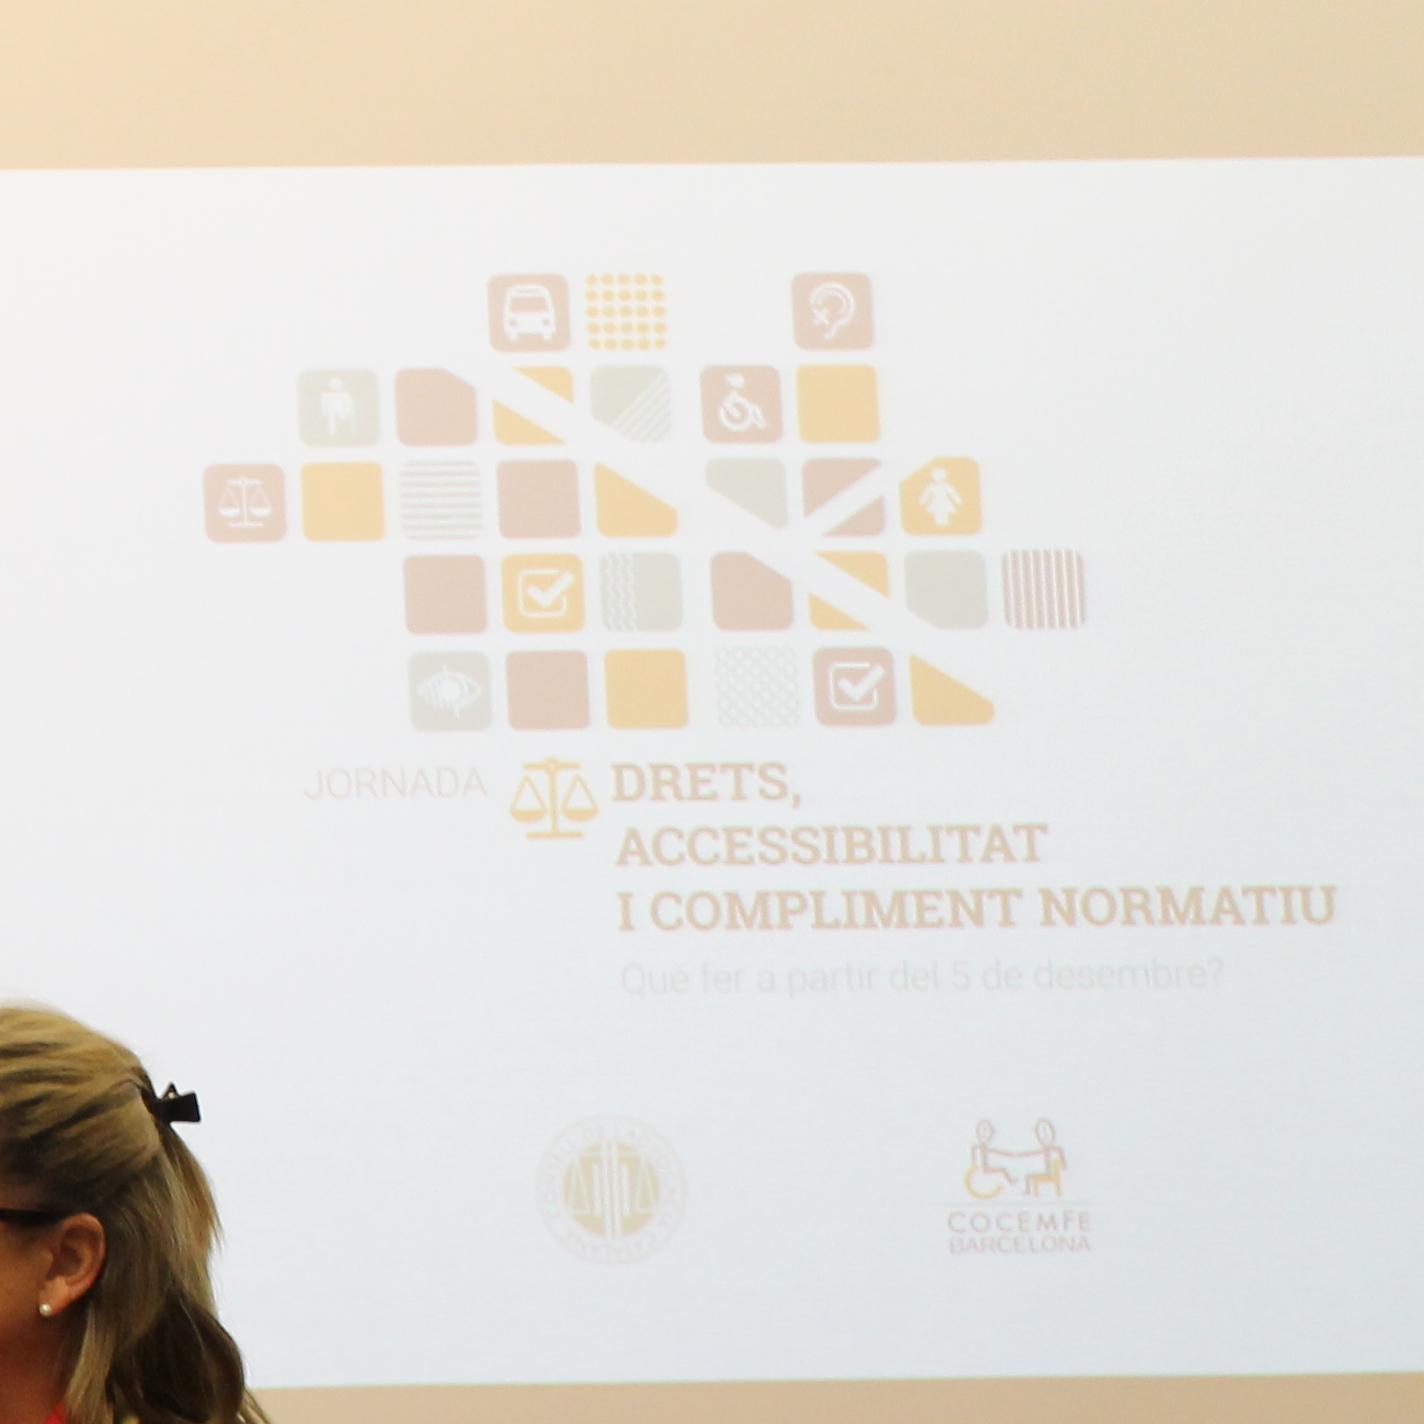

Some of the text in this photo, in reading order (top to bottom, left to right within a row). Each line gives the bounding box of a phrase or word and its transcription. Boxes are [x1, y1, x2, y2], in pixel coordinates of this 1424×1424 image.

[303, 761, 802, 808] JORNADA DRETS,
[615, 823, 1049, 867] ACCESSIBILITAT
[617, 885, 1338, 931] I COMPLIMENT NORMATIU
[700, 961, 745, 994] fer
[758, 969, 776, 994] a
[786, 961, 881, 1001] partir
[889, 959, 940, 993] del
[951, 960, 971, 992] 5
[981, 958, 1024, 992] de
[1033, 956, 1225, 991] desembre?
[947, 1209, 1091, 1233] COCEMFE
[949, 1234, 1092, 1255] BARCELONA
